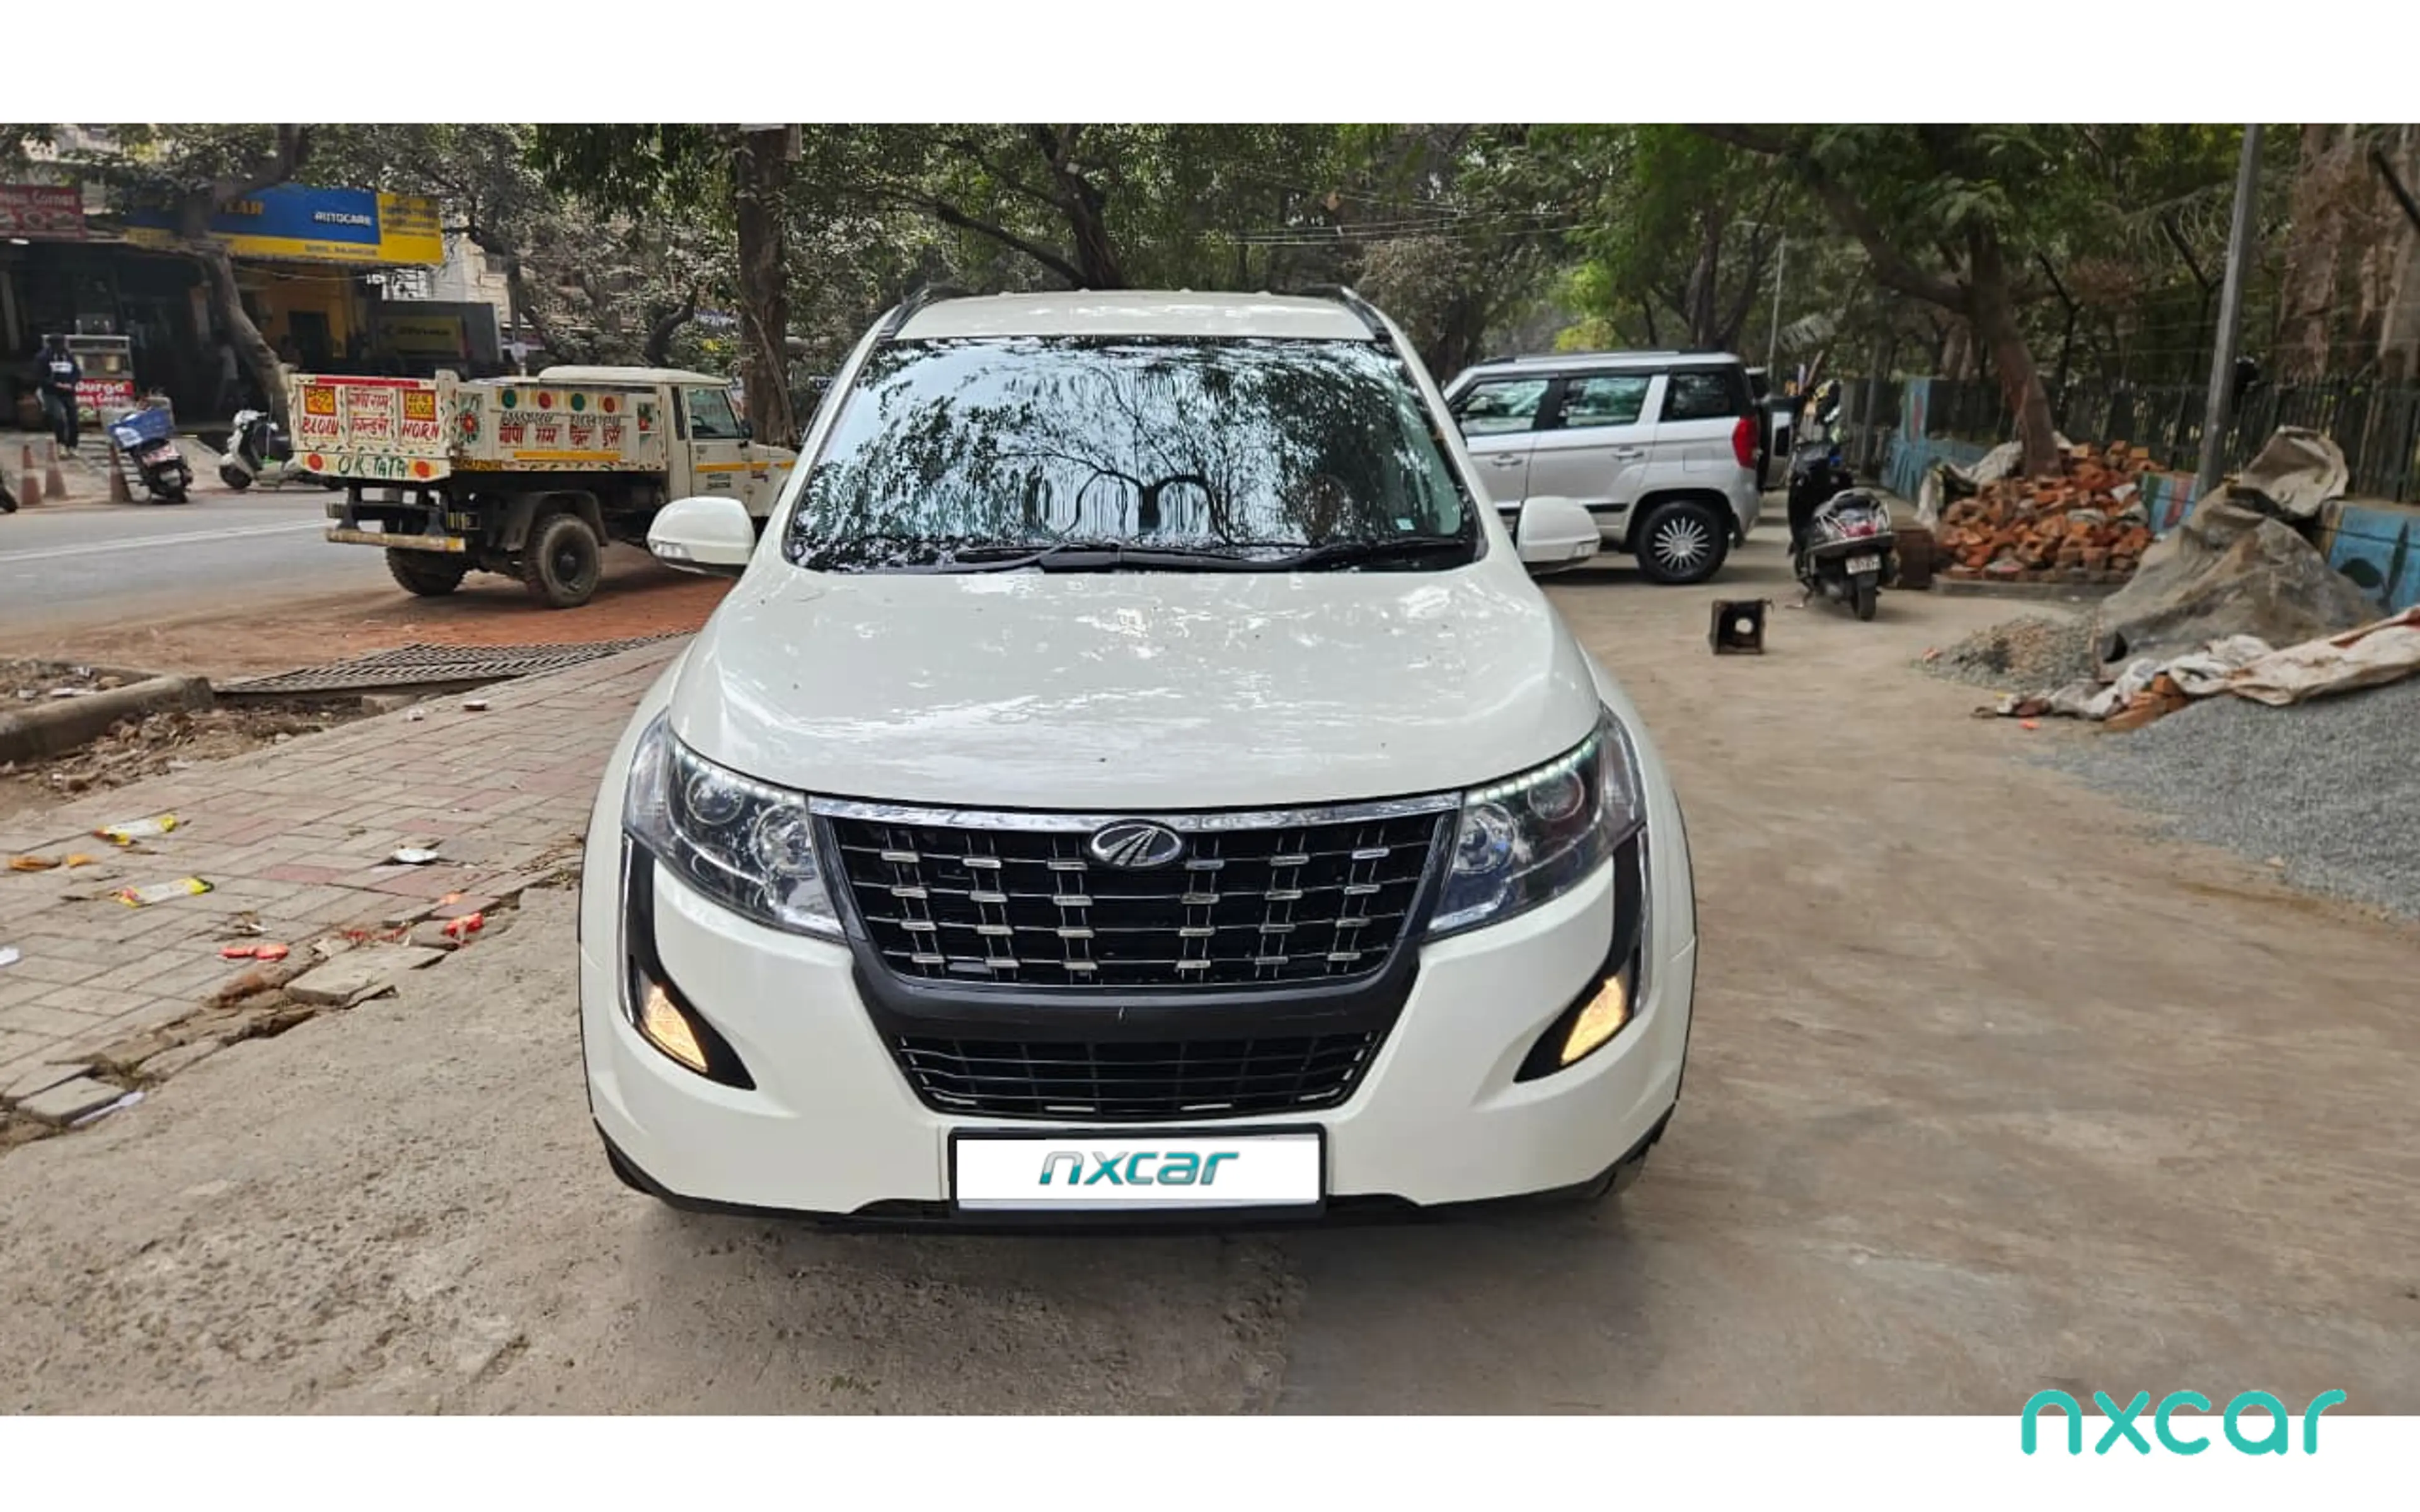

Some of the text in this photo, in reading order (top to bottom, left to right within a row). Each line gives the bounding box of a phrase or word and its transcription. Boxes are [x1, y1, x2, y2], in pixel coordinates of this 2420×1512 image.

[302, 416, 339, 435] BLOW
[402, 423, 440, 440] HORN
[374, 456, 406, 477] TATA
